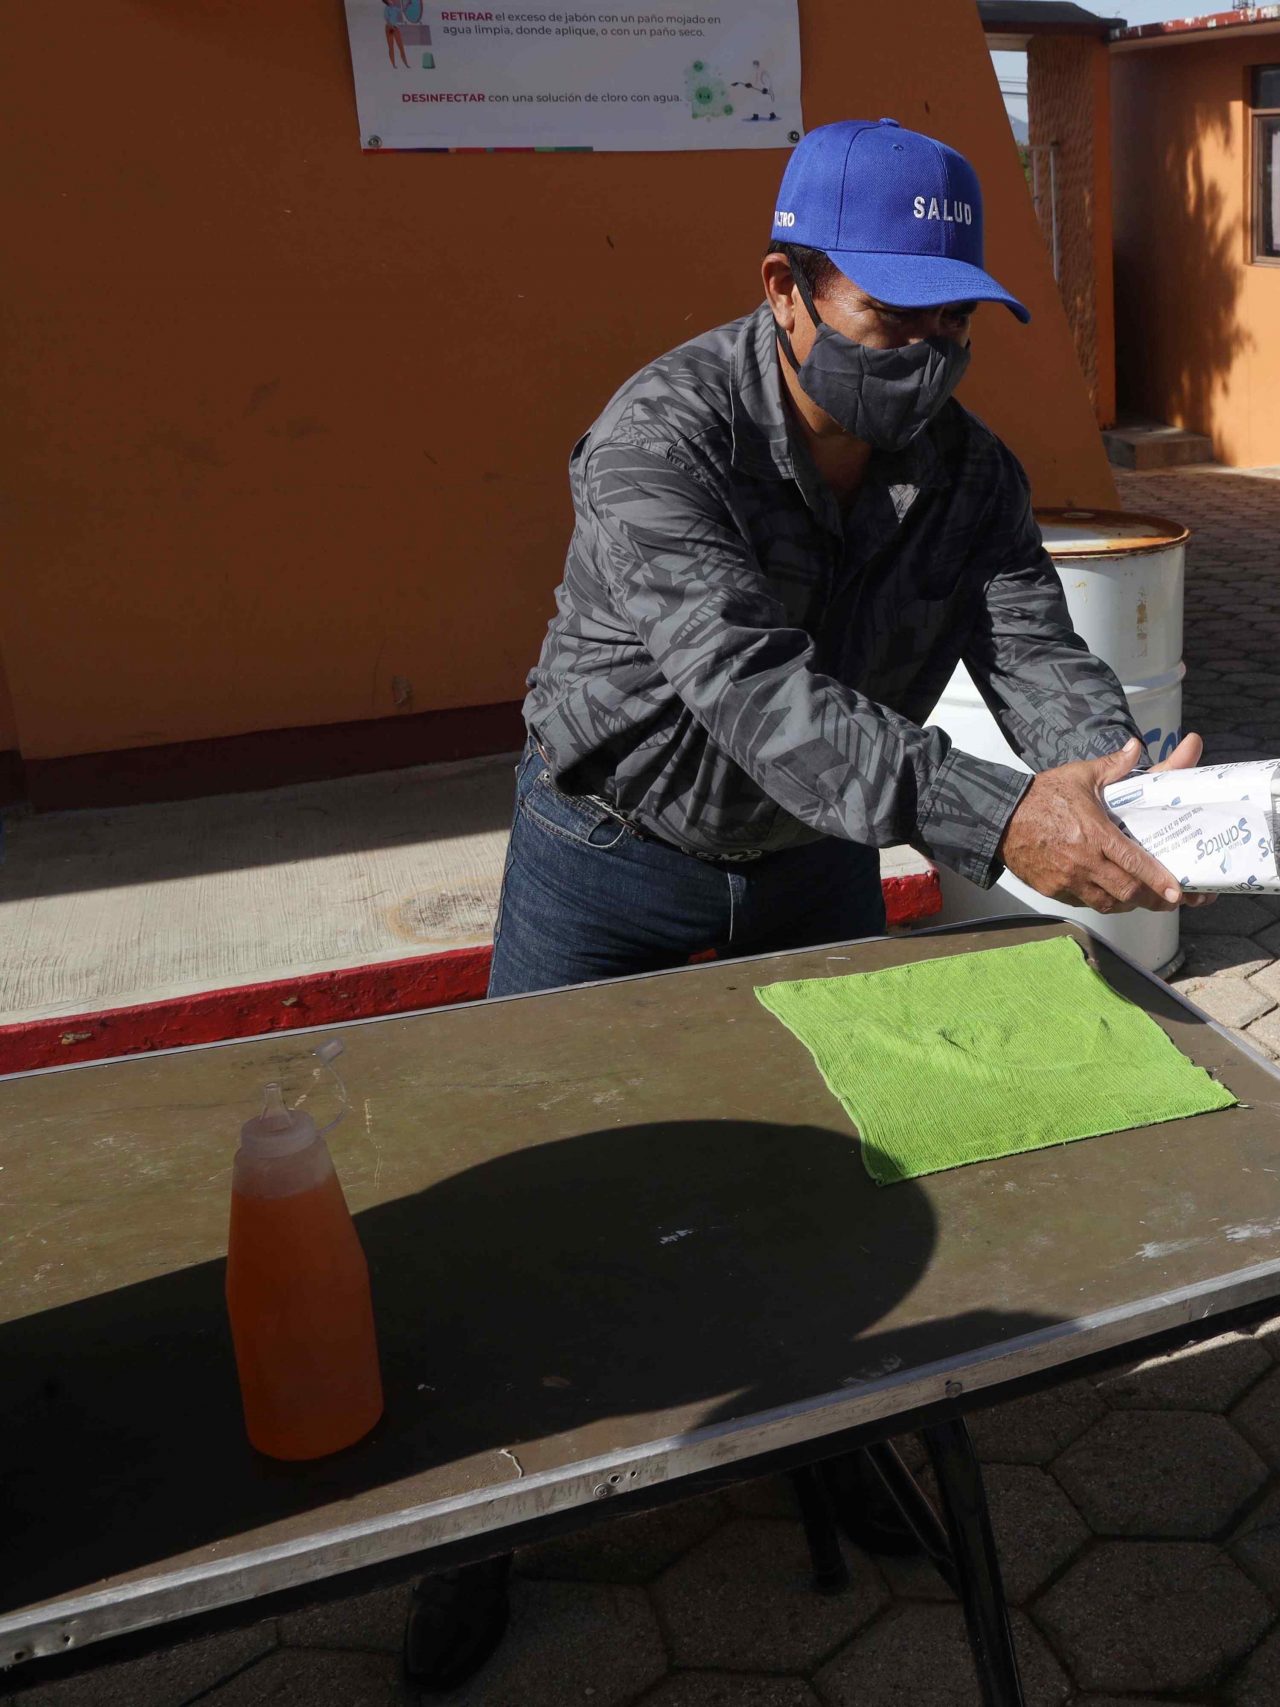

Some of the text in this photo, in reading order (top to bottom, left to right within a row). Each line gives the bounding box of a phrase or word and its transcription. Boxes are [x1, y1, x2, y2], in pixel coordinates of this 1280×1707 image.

[441, 11, 721, 25] RETIRAR el exceso de jabón con un paño mojado en
[443, 25, 705, 37] agua limpia, donde aplique, o con un paño seco.
[402, 93, 485, 103] DESINFECTAR
[536, 92, 581, 103] solución
[585, 93, 598, 102] de
[601, 93, 628, 102] cloro
[653, 95, 682, 104] agua.
[913, 196, 972, 225] SALUD
[774, 210, 795, 227] ILTRO
[1196, 817, 1252, 860] Sanitas
